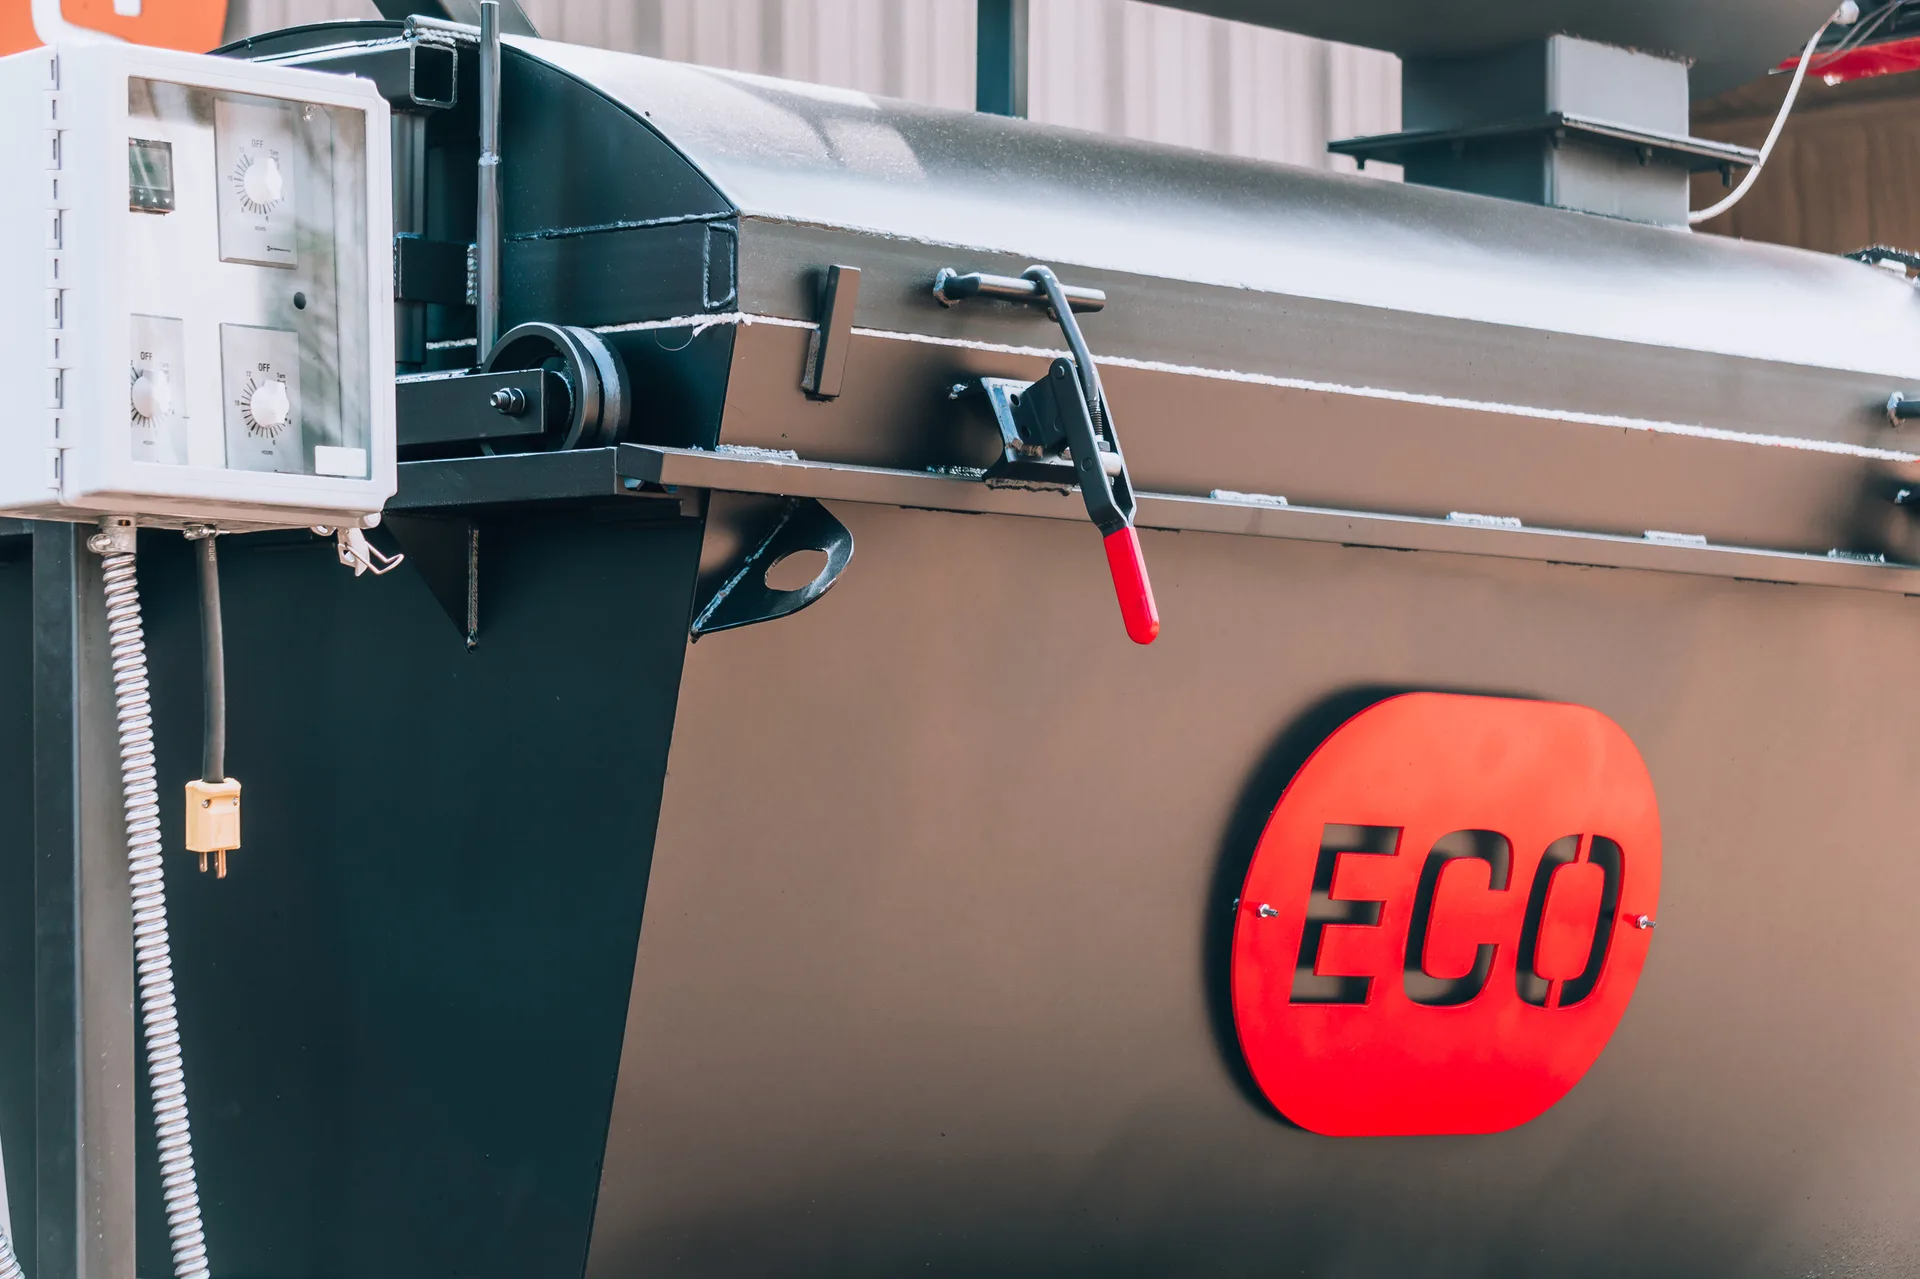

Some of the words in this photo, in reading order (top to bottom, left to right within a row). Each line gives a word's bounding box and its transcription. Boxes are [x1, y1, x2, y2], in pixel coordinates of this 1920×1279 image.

[251, 139, 264, 148] OFF
[140, 351, 153, 360] OFF
[258, 362, 271, 372] OFF
[1289, 822, 1626, 1011] ECO
